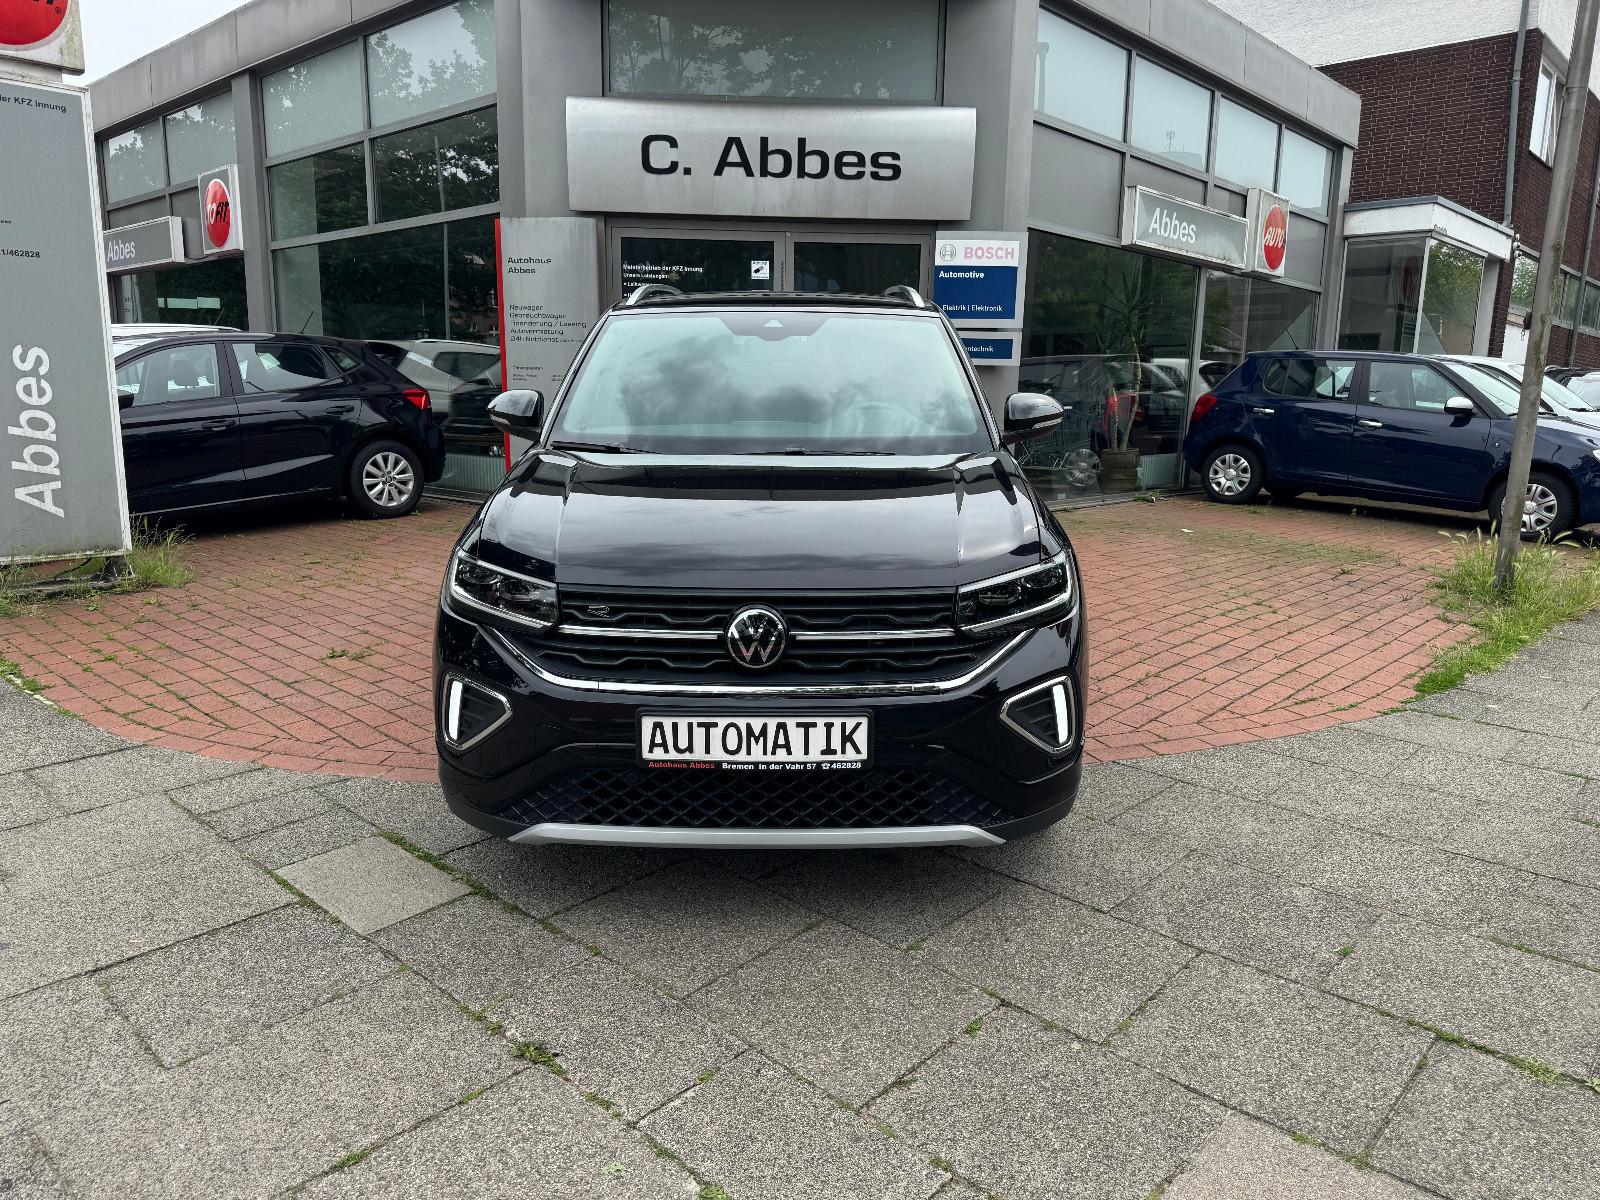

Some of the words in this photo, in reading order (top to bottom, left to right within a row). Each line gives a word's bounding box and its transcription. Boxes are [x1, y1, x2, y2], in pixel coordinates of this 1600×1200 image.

[13, 96, 33, 107] KFZ
[35, 100, 67, 114] Innung
[640, 133, 692, 175] C.
[713, 136, 902, 181] Abbes
[1149, 207, 1197, 244] Abbes
[107, 239, 136, 261] Abbes
[963, 246, 1015, 260] BOSCH
[507, 257, 552, 265] Autohaus
[938, 270, 985, 279] Automotive
[942, 304, 966, 312] Elektrik
[7, 344, 65, 518] Abbes
[648, 721, 862, 756] AUTOMATIK
[648, 761, 688, 769] Autohaus
[722, 762, 754, 770] Bremen
[830, 762, 862, 770] 462828
